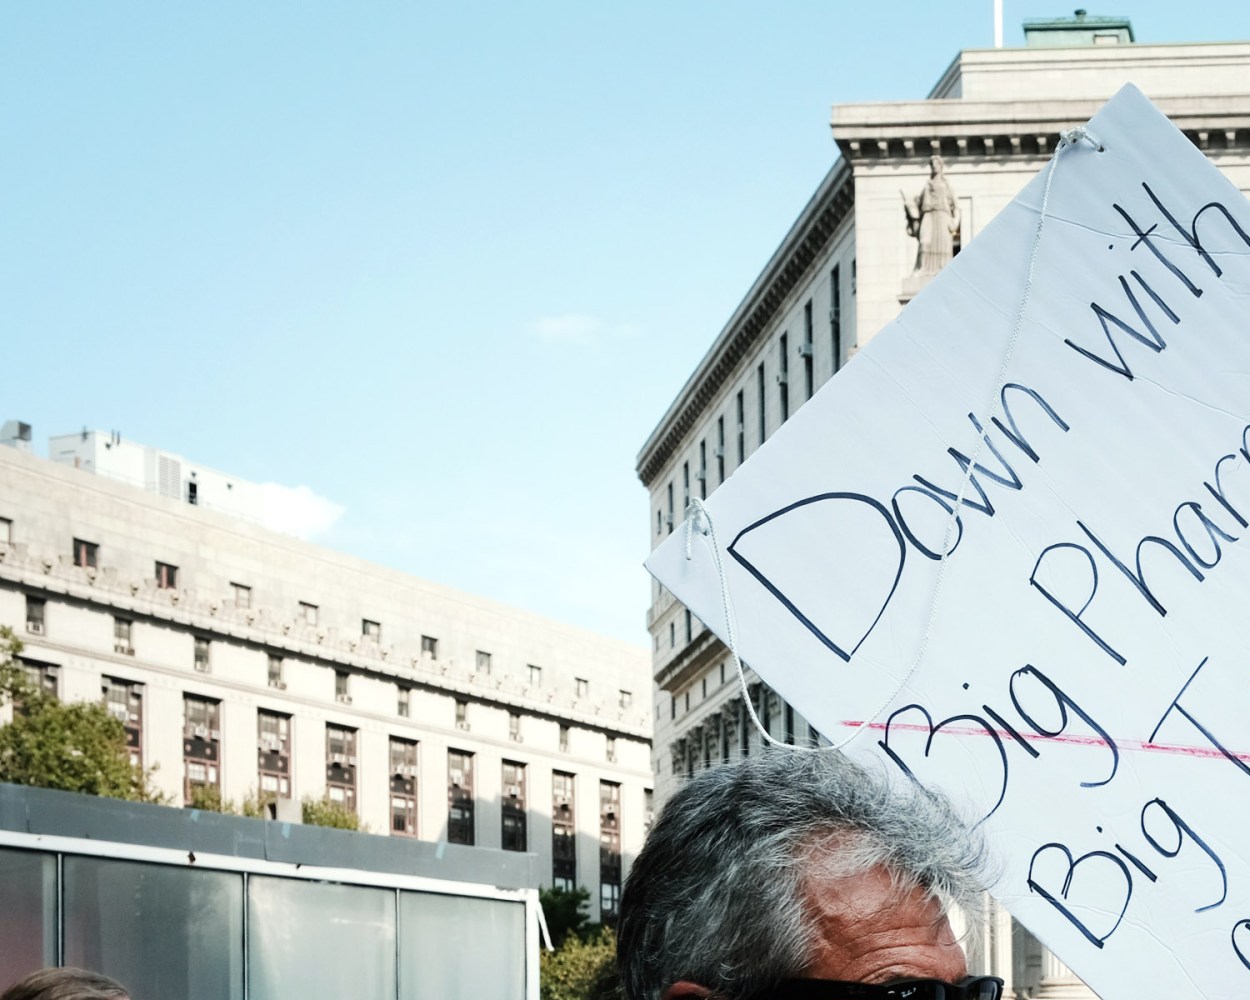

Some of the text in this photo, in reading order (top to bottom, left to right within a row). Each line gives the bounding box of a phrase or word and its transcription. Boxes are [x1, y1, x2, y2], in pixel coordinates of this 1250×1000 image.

[726, 382, 1070, 664] Down
[878, 664, 1119, 832] Big
[1026, 797, 1228, 949] Big
